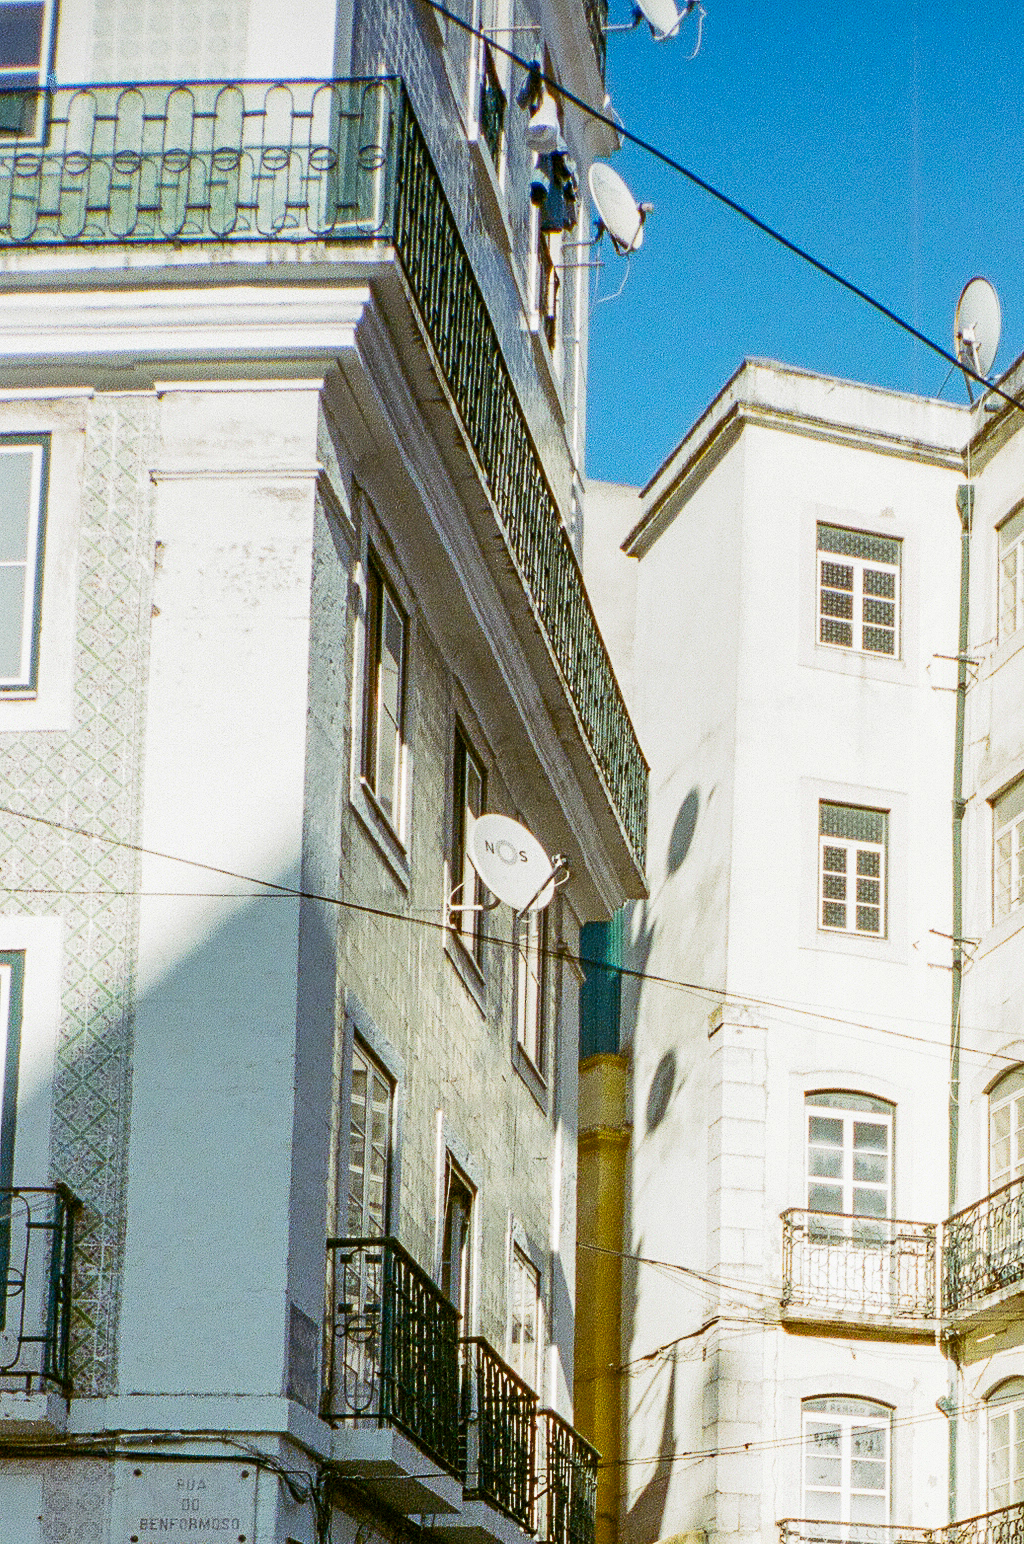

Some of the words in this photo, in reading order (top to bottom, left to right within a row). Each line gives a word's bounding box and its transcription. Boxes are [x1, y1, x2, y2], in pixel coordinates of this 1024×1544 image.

[484, 840, 529, 865] NOS
[176, 1478, 207, 1491] RUA
[181, 1498, 200, 1511] DO
[139, 1517, 240, 1531] BENFORMOSO
